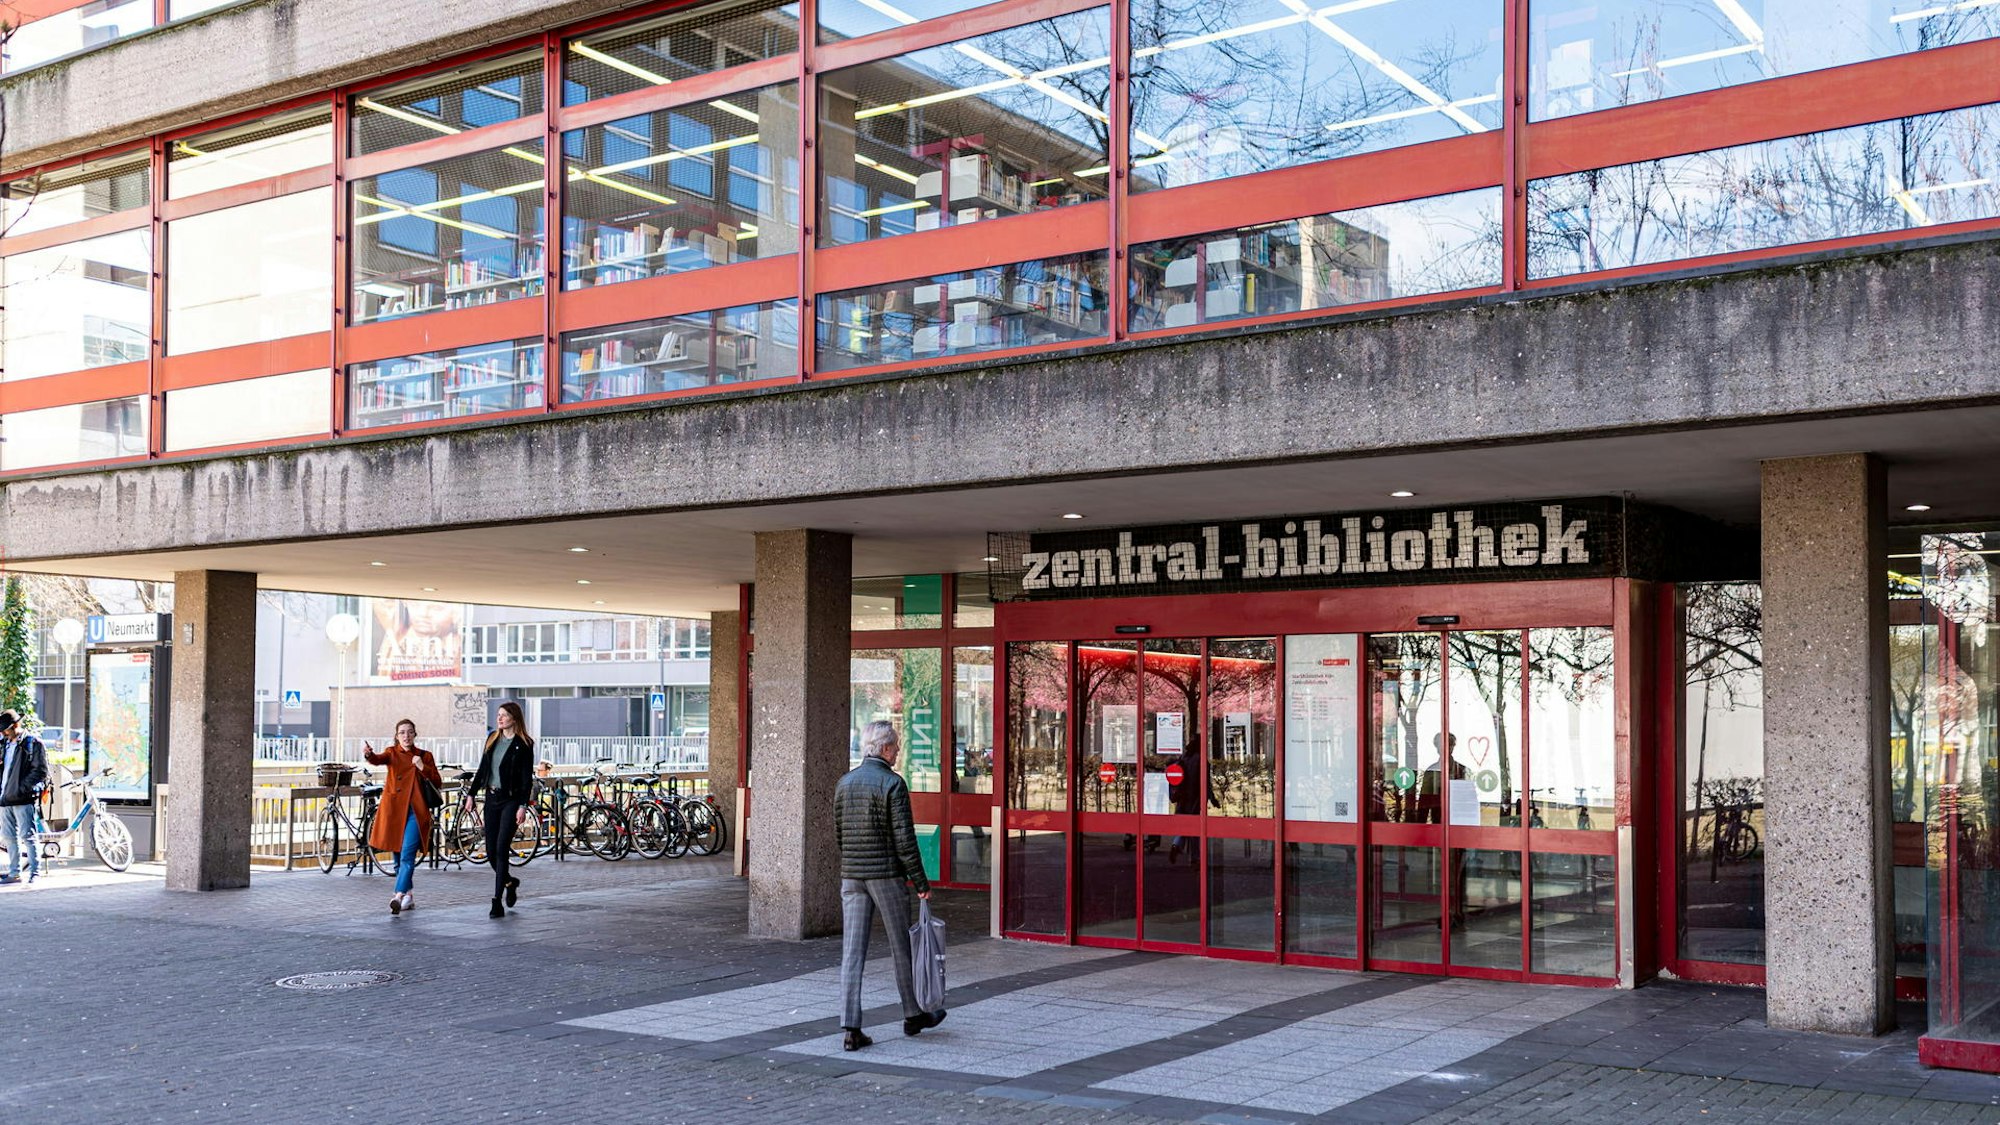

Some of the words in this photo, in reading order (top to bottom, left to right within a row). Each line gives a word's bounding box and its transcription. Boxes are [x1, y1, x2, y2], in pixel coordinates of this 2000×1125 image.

[1022, 505, 1590, 590] zentral-bibliothek
[90, 619, 103, 640] U
[107, 620, 155, 636] Neumarkt
[391, 671, 428, 681] COMING
[430, 669, 456, 678] SOON
